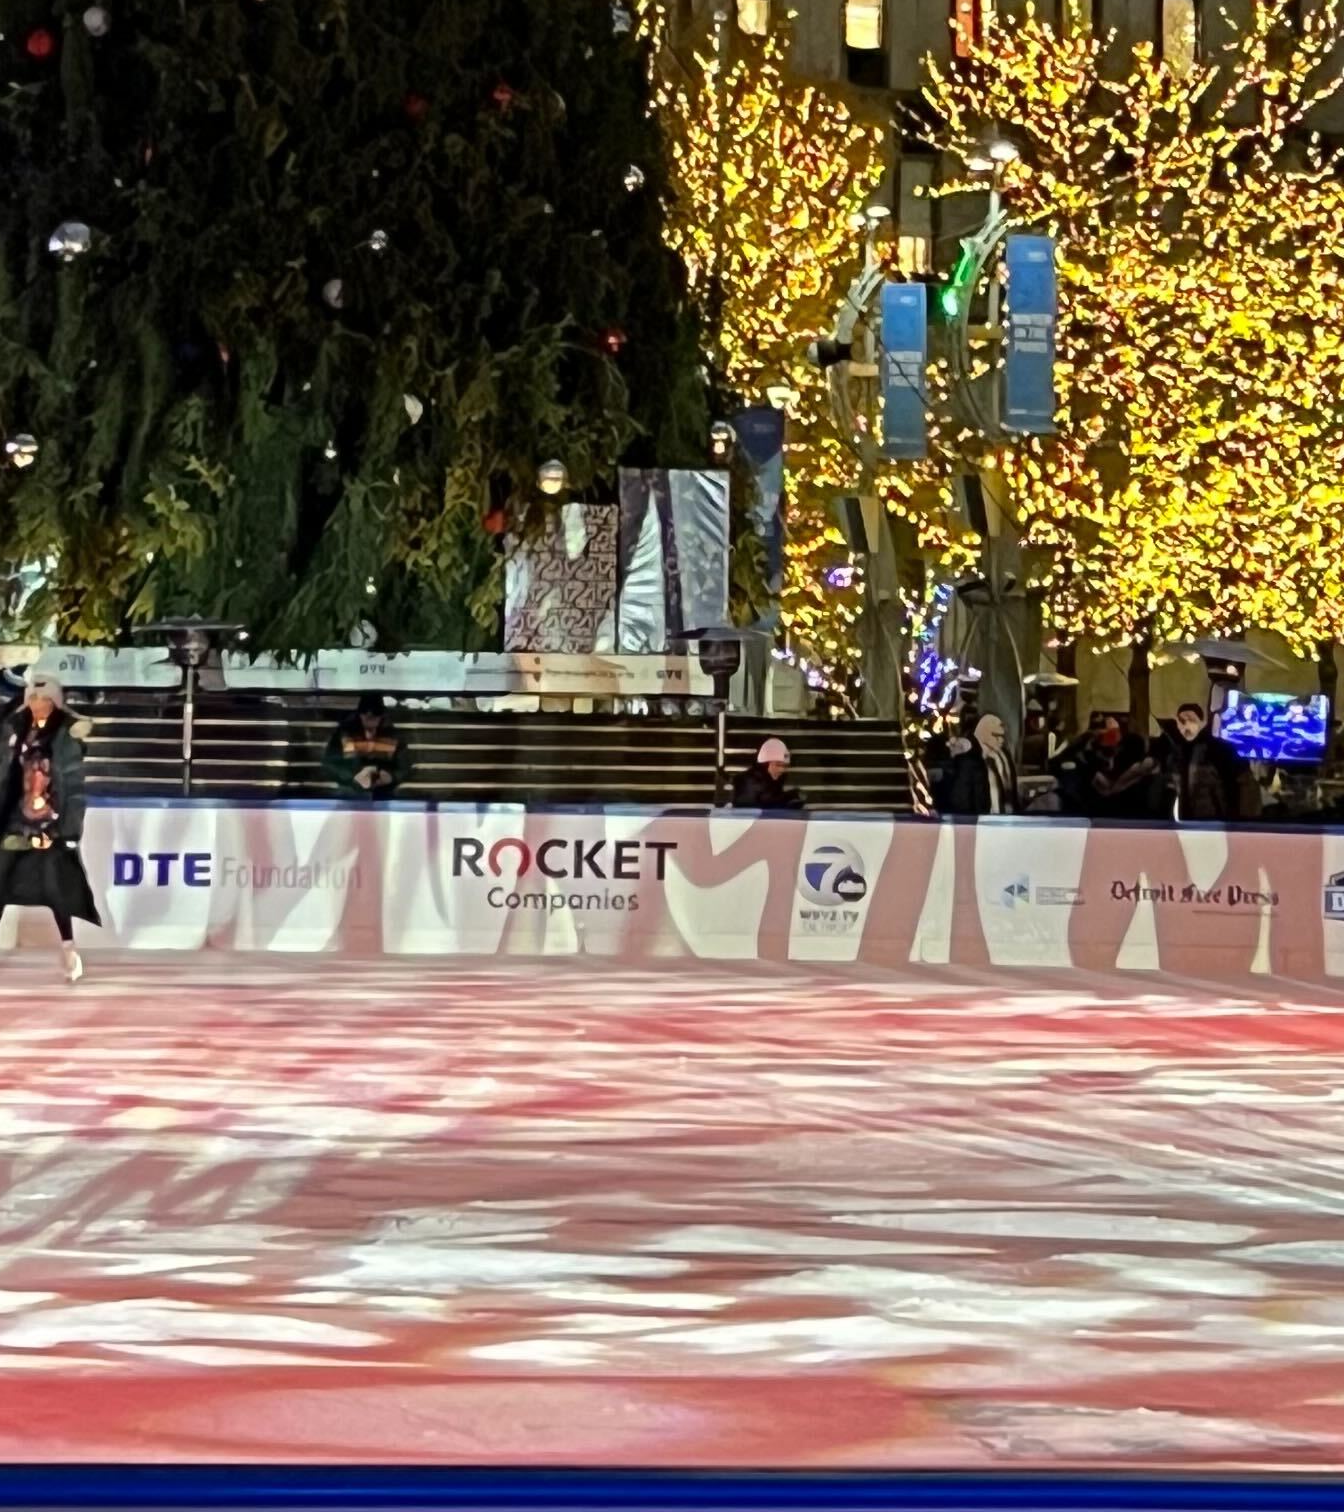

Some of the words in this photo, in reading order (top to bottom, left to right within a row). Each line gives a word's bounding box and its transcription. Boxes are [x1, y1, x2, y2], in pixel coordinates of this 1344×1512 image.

[113, 853, 212, 887] DTE
[221, 857, 362, 889] Foundation
[452, 837, 678, 880] ROCKET
[487, 886, 641, 915] Companies
